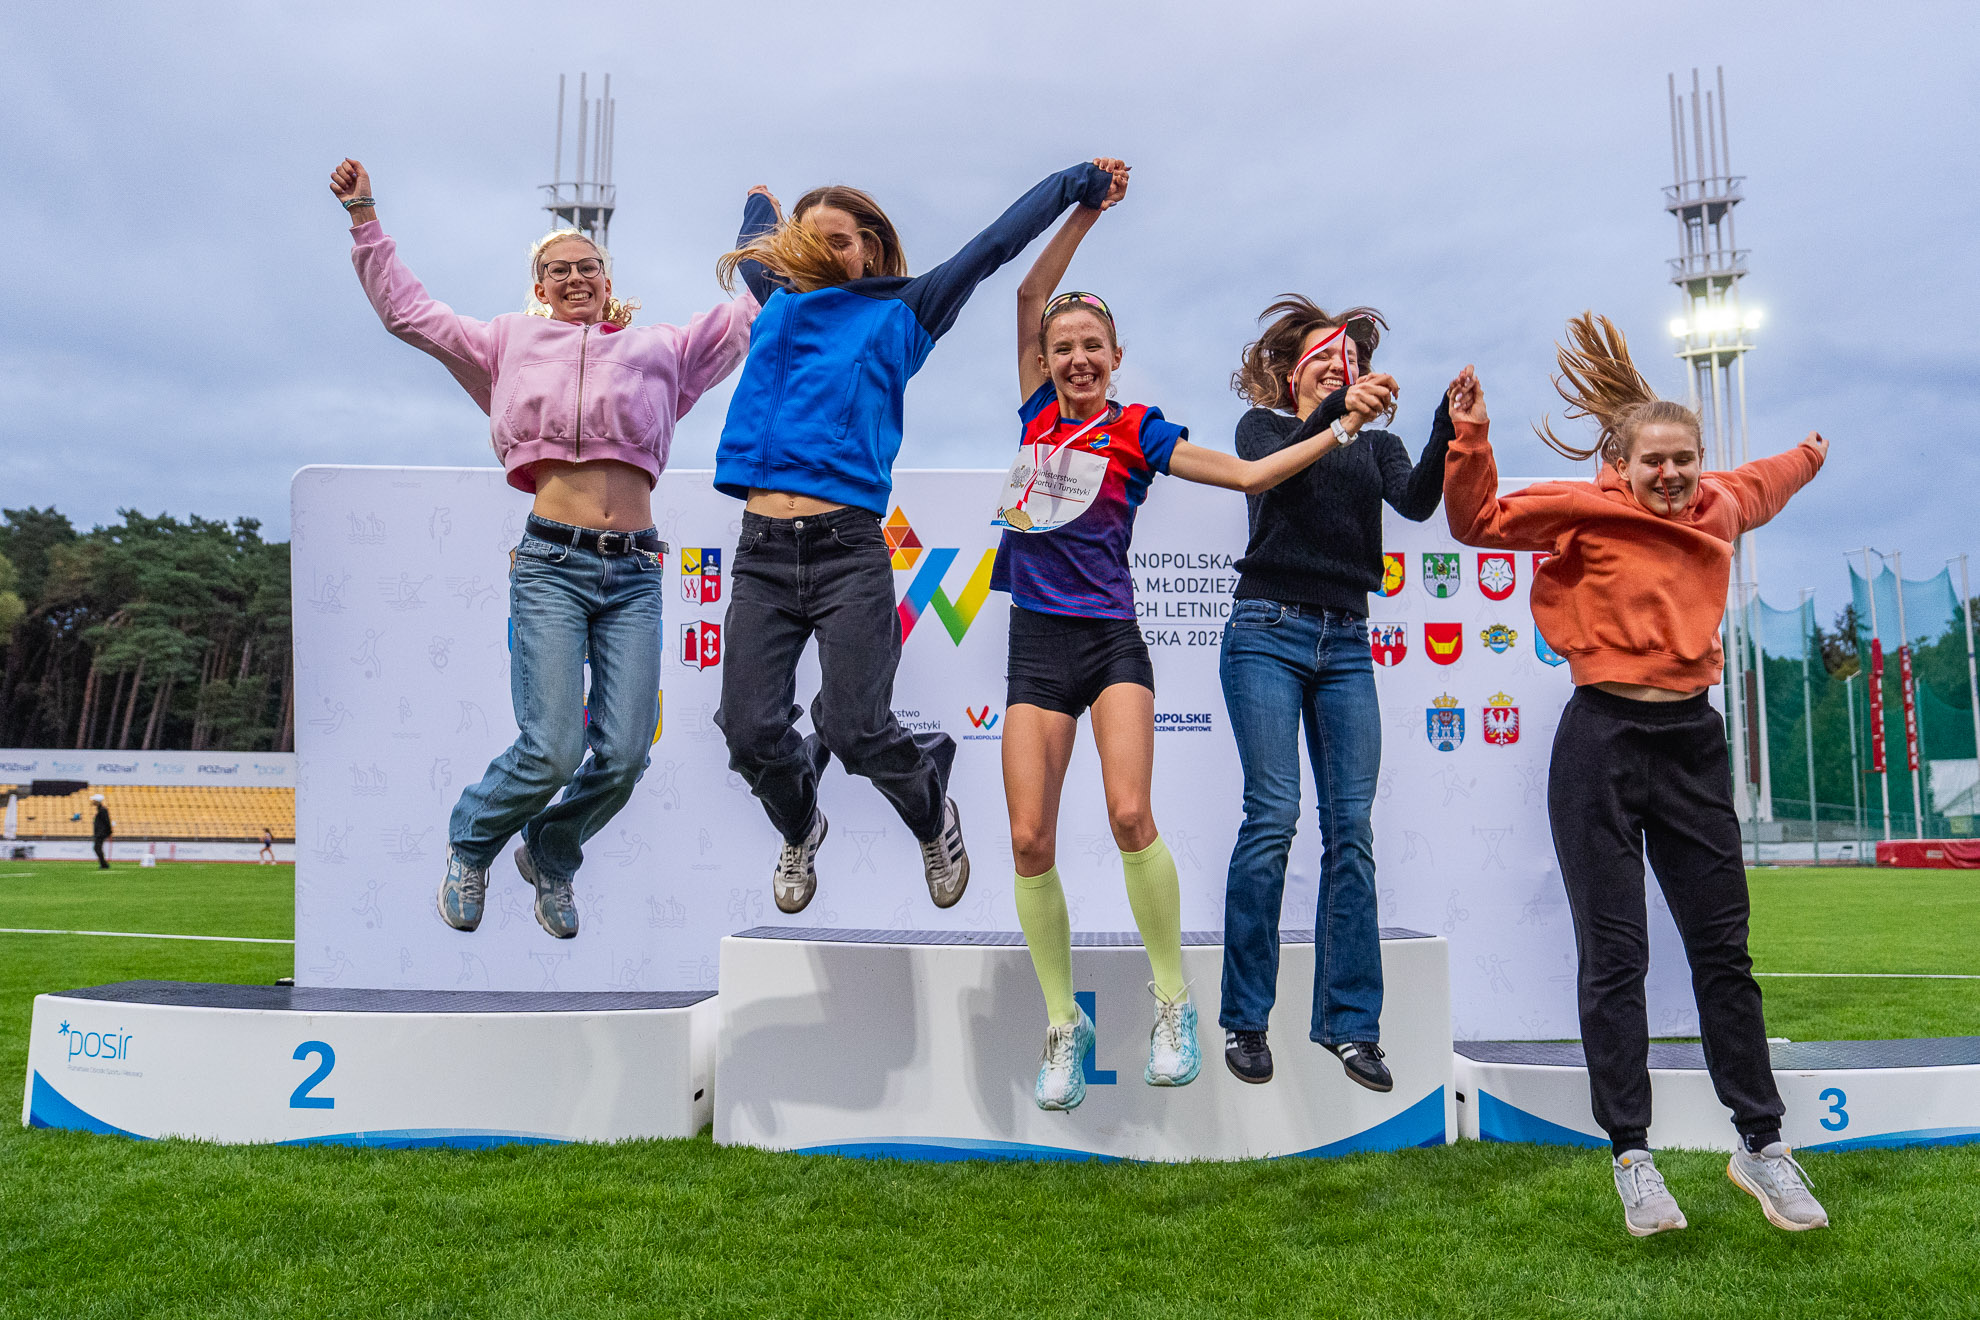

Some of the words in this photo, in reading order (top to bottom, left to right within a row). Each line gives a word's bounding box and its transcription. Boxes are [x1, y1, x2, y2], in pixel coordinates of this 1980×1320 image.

[1058, 482, 1091, 496] Turystyki
[1130, 553, 1233, 569] NOPOLSKA
[1146, 575, 1237, 593] MŁODZIEŻ
[1165, 602, 1230, 617] LETNIC
[1145, 630, 1182, 646] SKA
[1154, 713, 1212, 724] OPOLSKIE
[68, 1026, 133, 1063] posir
[289, 1040, 336, 1109] 2
[1818, 1087, 1850, 1132] 3
